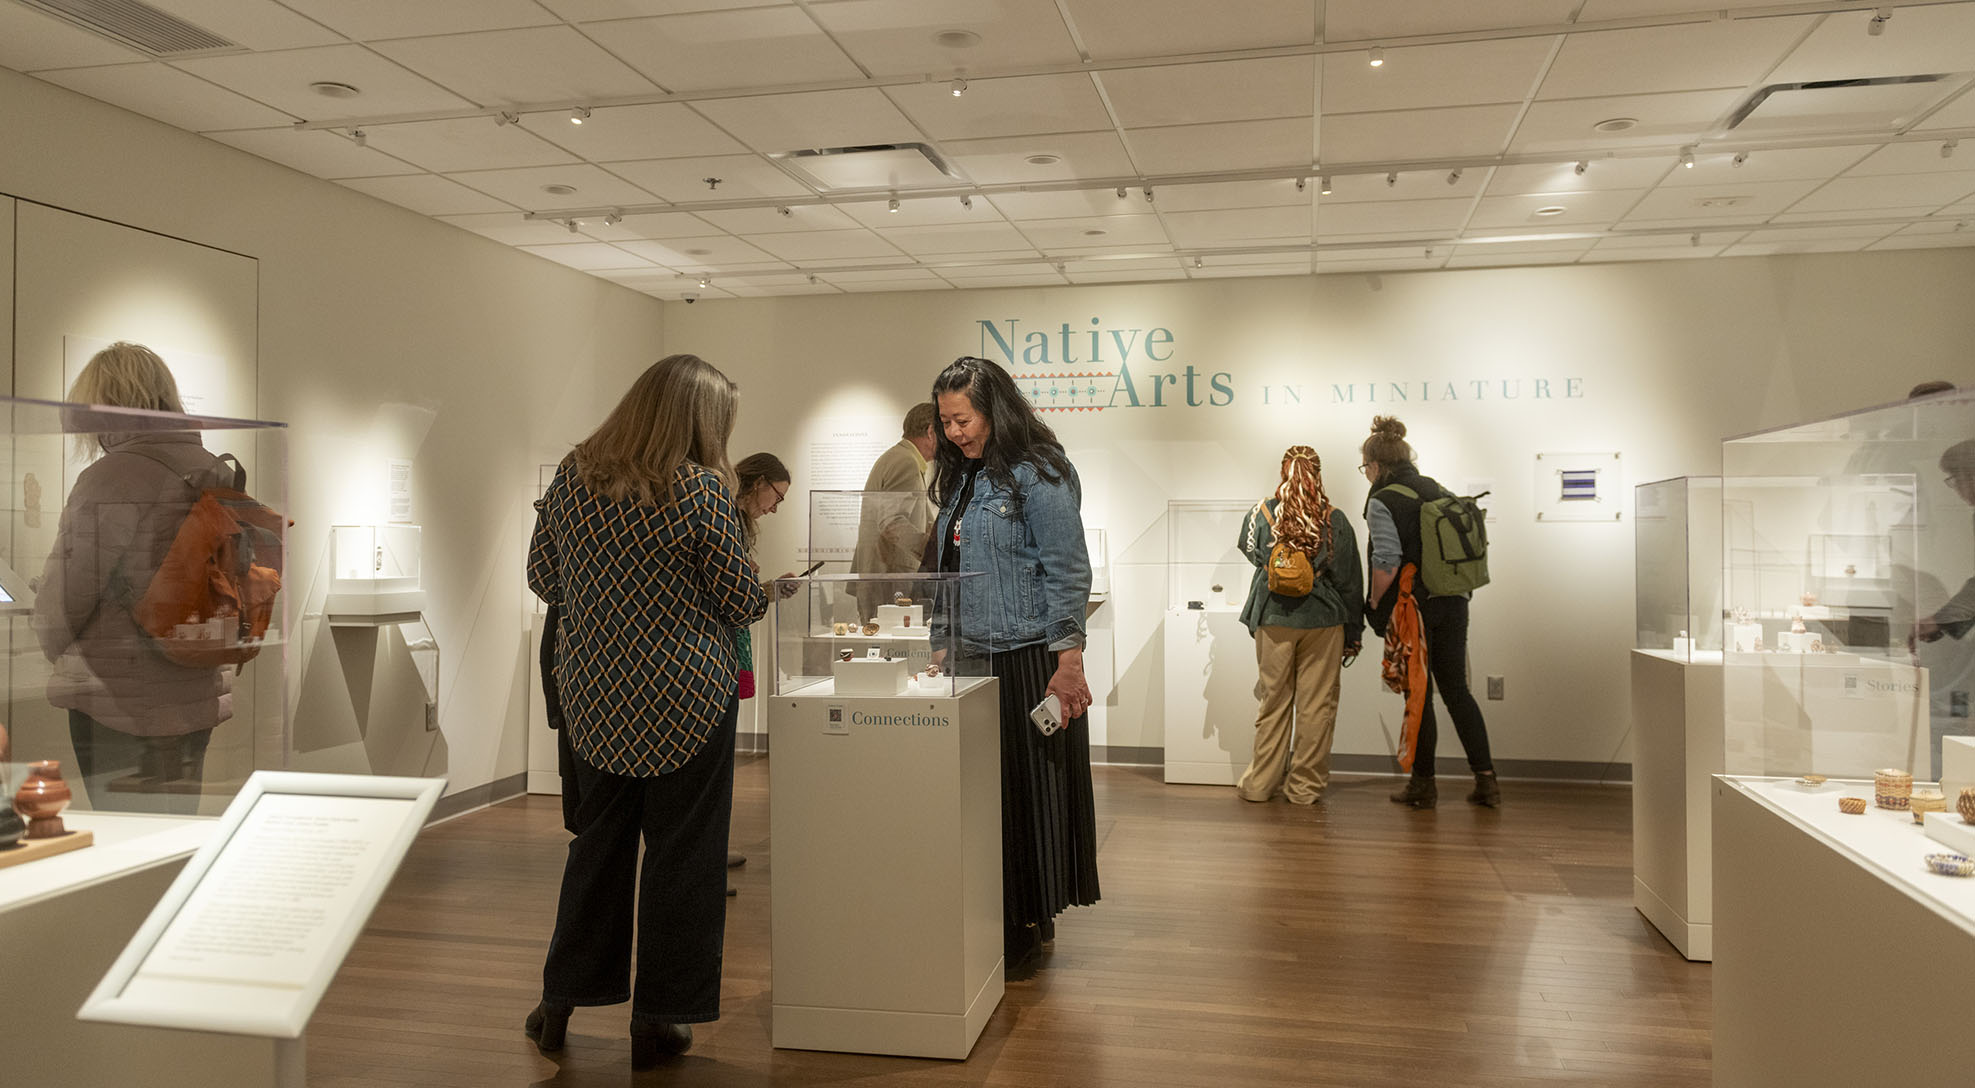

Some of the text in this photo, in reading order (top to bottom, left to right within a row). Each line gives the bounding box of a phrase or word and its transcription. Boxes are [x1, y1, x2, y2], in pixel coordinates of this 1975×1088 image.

[975, 316, 1175, 366] Native
[1107, 361, 1585, 408] Arts IN MINIATURE
[1866, 679, 1919, 693] Stories
[851, 711, 950, 727] Connections
